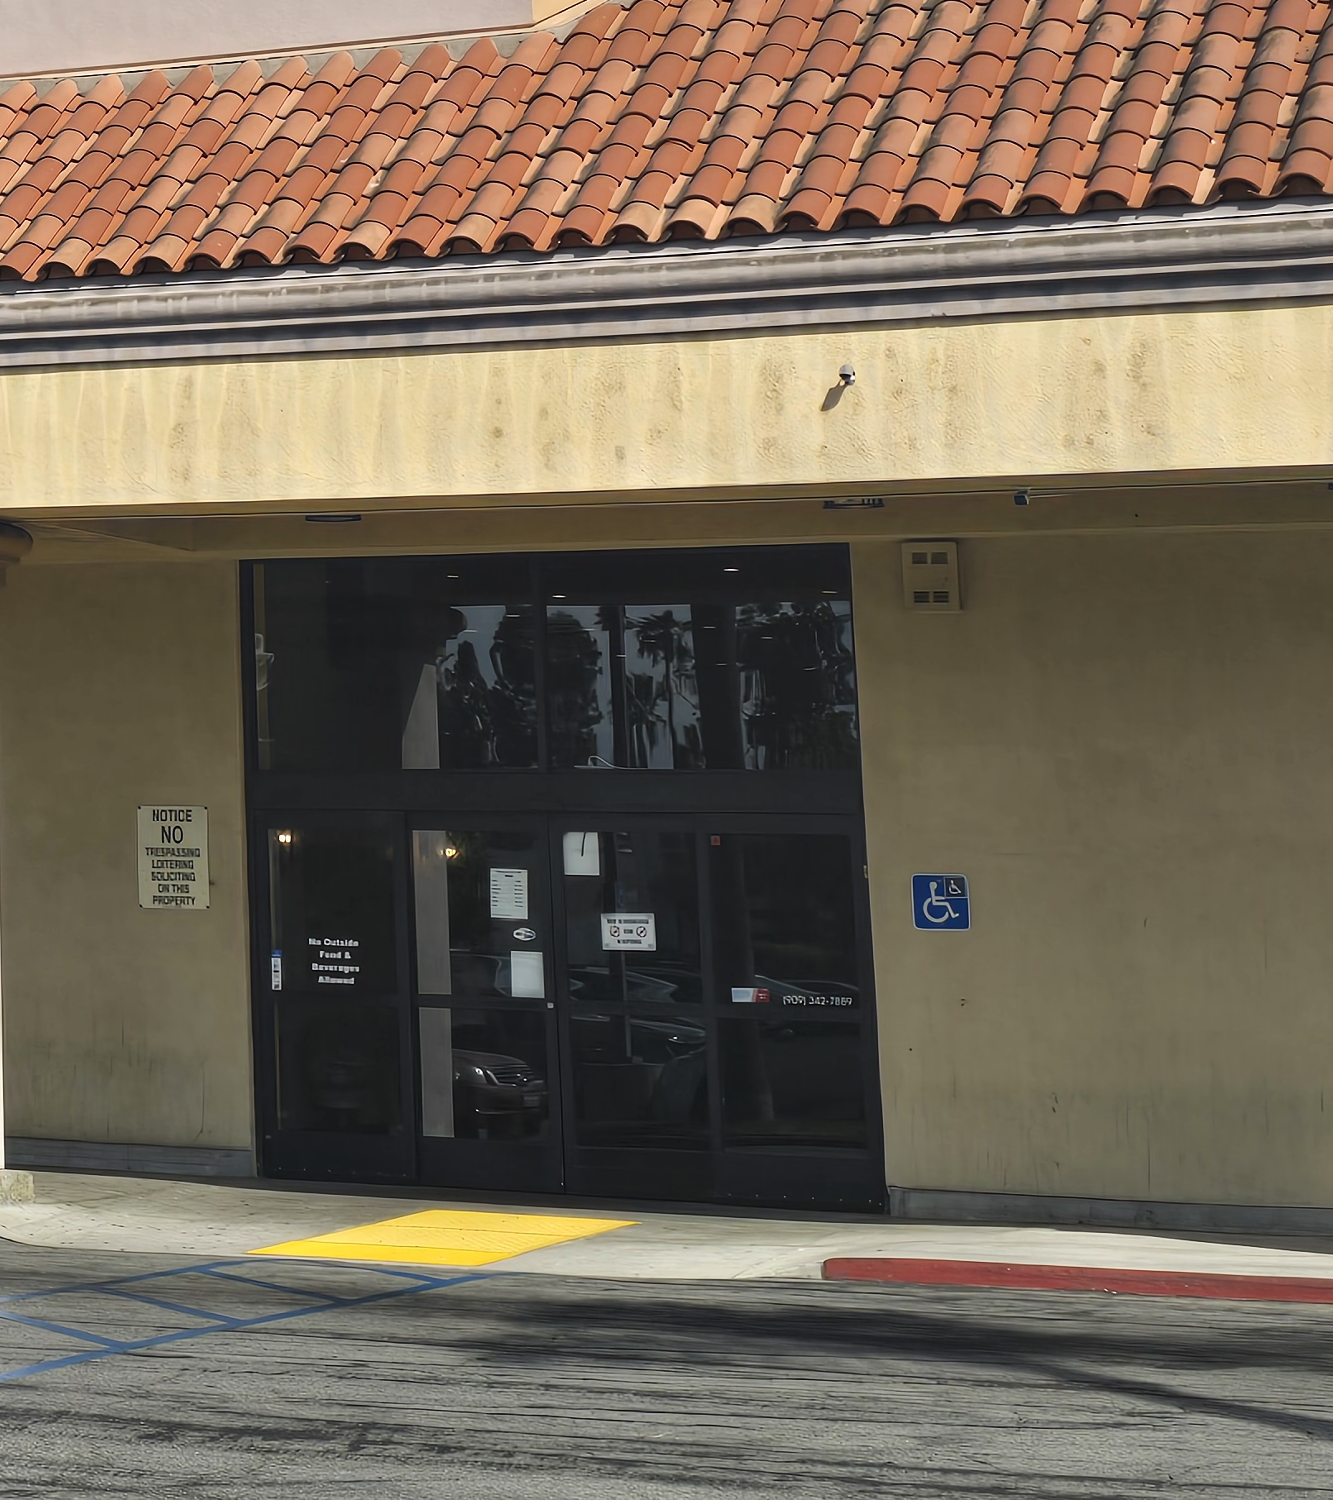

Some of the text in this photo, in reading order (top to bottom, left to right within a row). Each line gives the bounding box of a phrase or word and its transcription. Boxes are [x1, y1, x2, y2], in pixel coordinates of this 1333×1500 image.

[152, 809, 193, 822] NOTICE
[161, 825, 184, 844] NO
[145, 847, 201, 857] TRESPASSING
[152, 860, 194, 869] LOITERING
[151, 872, 196, 882] SOLICITING
[158, 884, 190, 894] ON THIS
[152, 895, 196, 906] PROPERTY
[323, 938, 359, 947] Outside
[319, 951, 342, 959] Food
